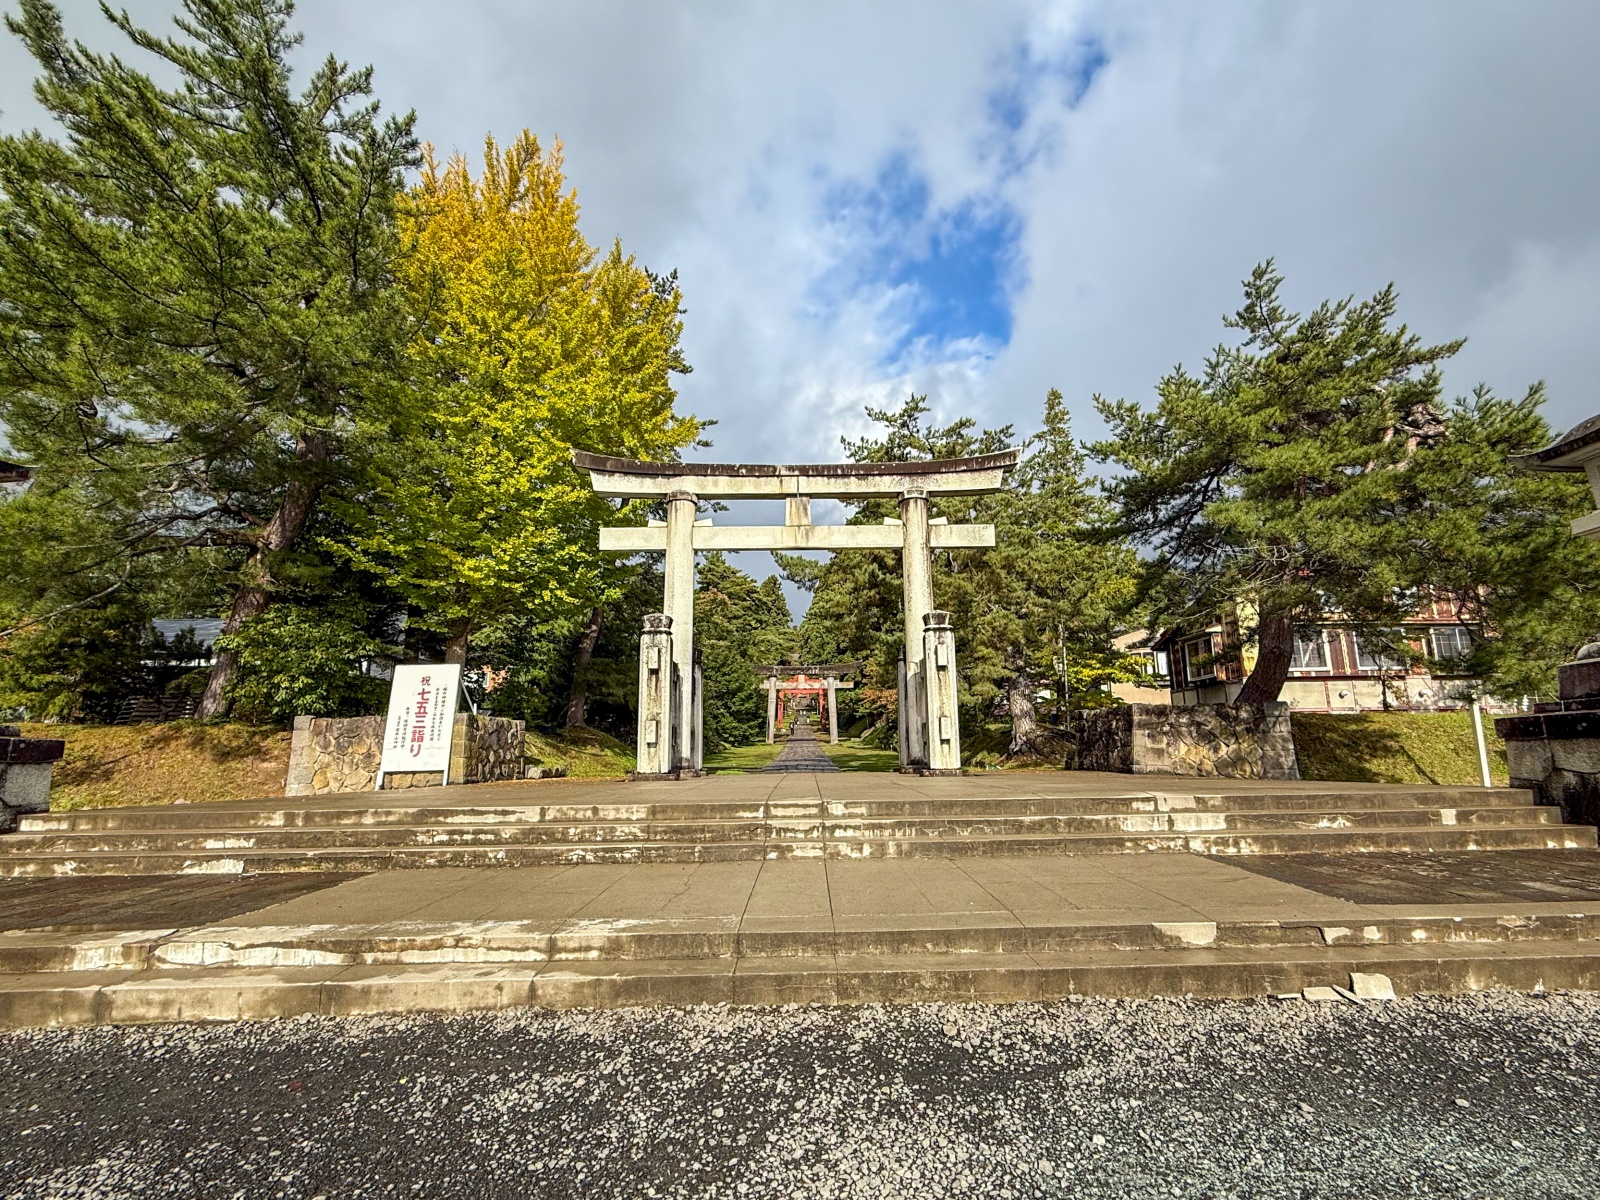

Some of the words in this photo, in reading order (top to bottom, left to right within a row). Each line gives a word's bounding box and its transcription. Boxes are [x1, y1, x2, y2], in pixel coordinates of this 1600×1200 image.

[420, 676, 431, 686] 祝
[409, 688, 431, 758] 七五三詣り
